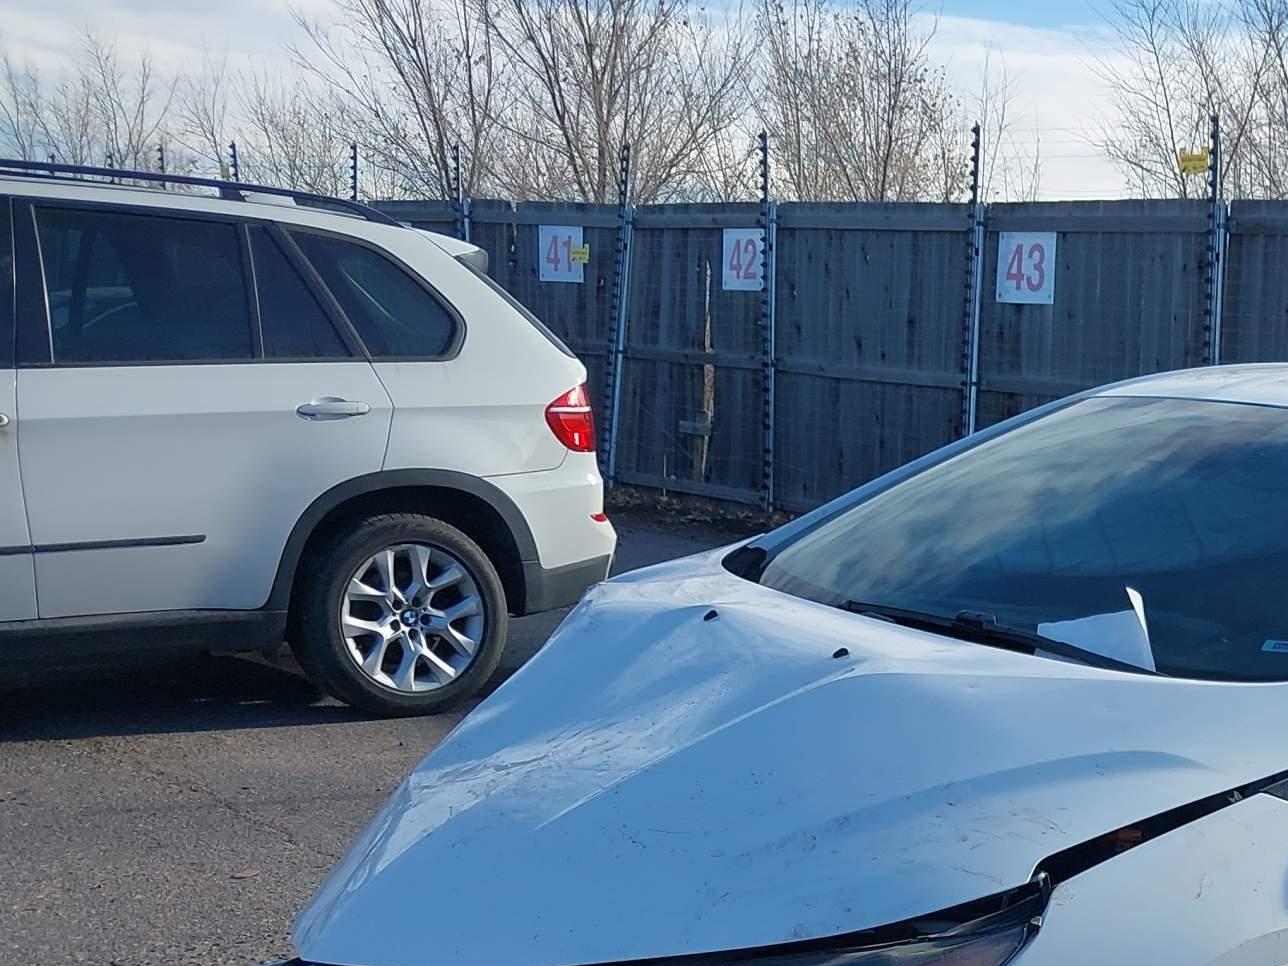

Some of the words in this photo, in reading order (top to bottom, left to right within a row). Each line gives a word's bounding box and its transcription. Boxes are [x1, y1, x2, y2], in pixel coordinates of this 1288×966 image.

[546, 234, 573, 273] 41
[729, 238, 758, 280] 42
[1006, 242, 1046, 293] 43
